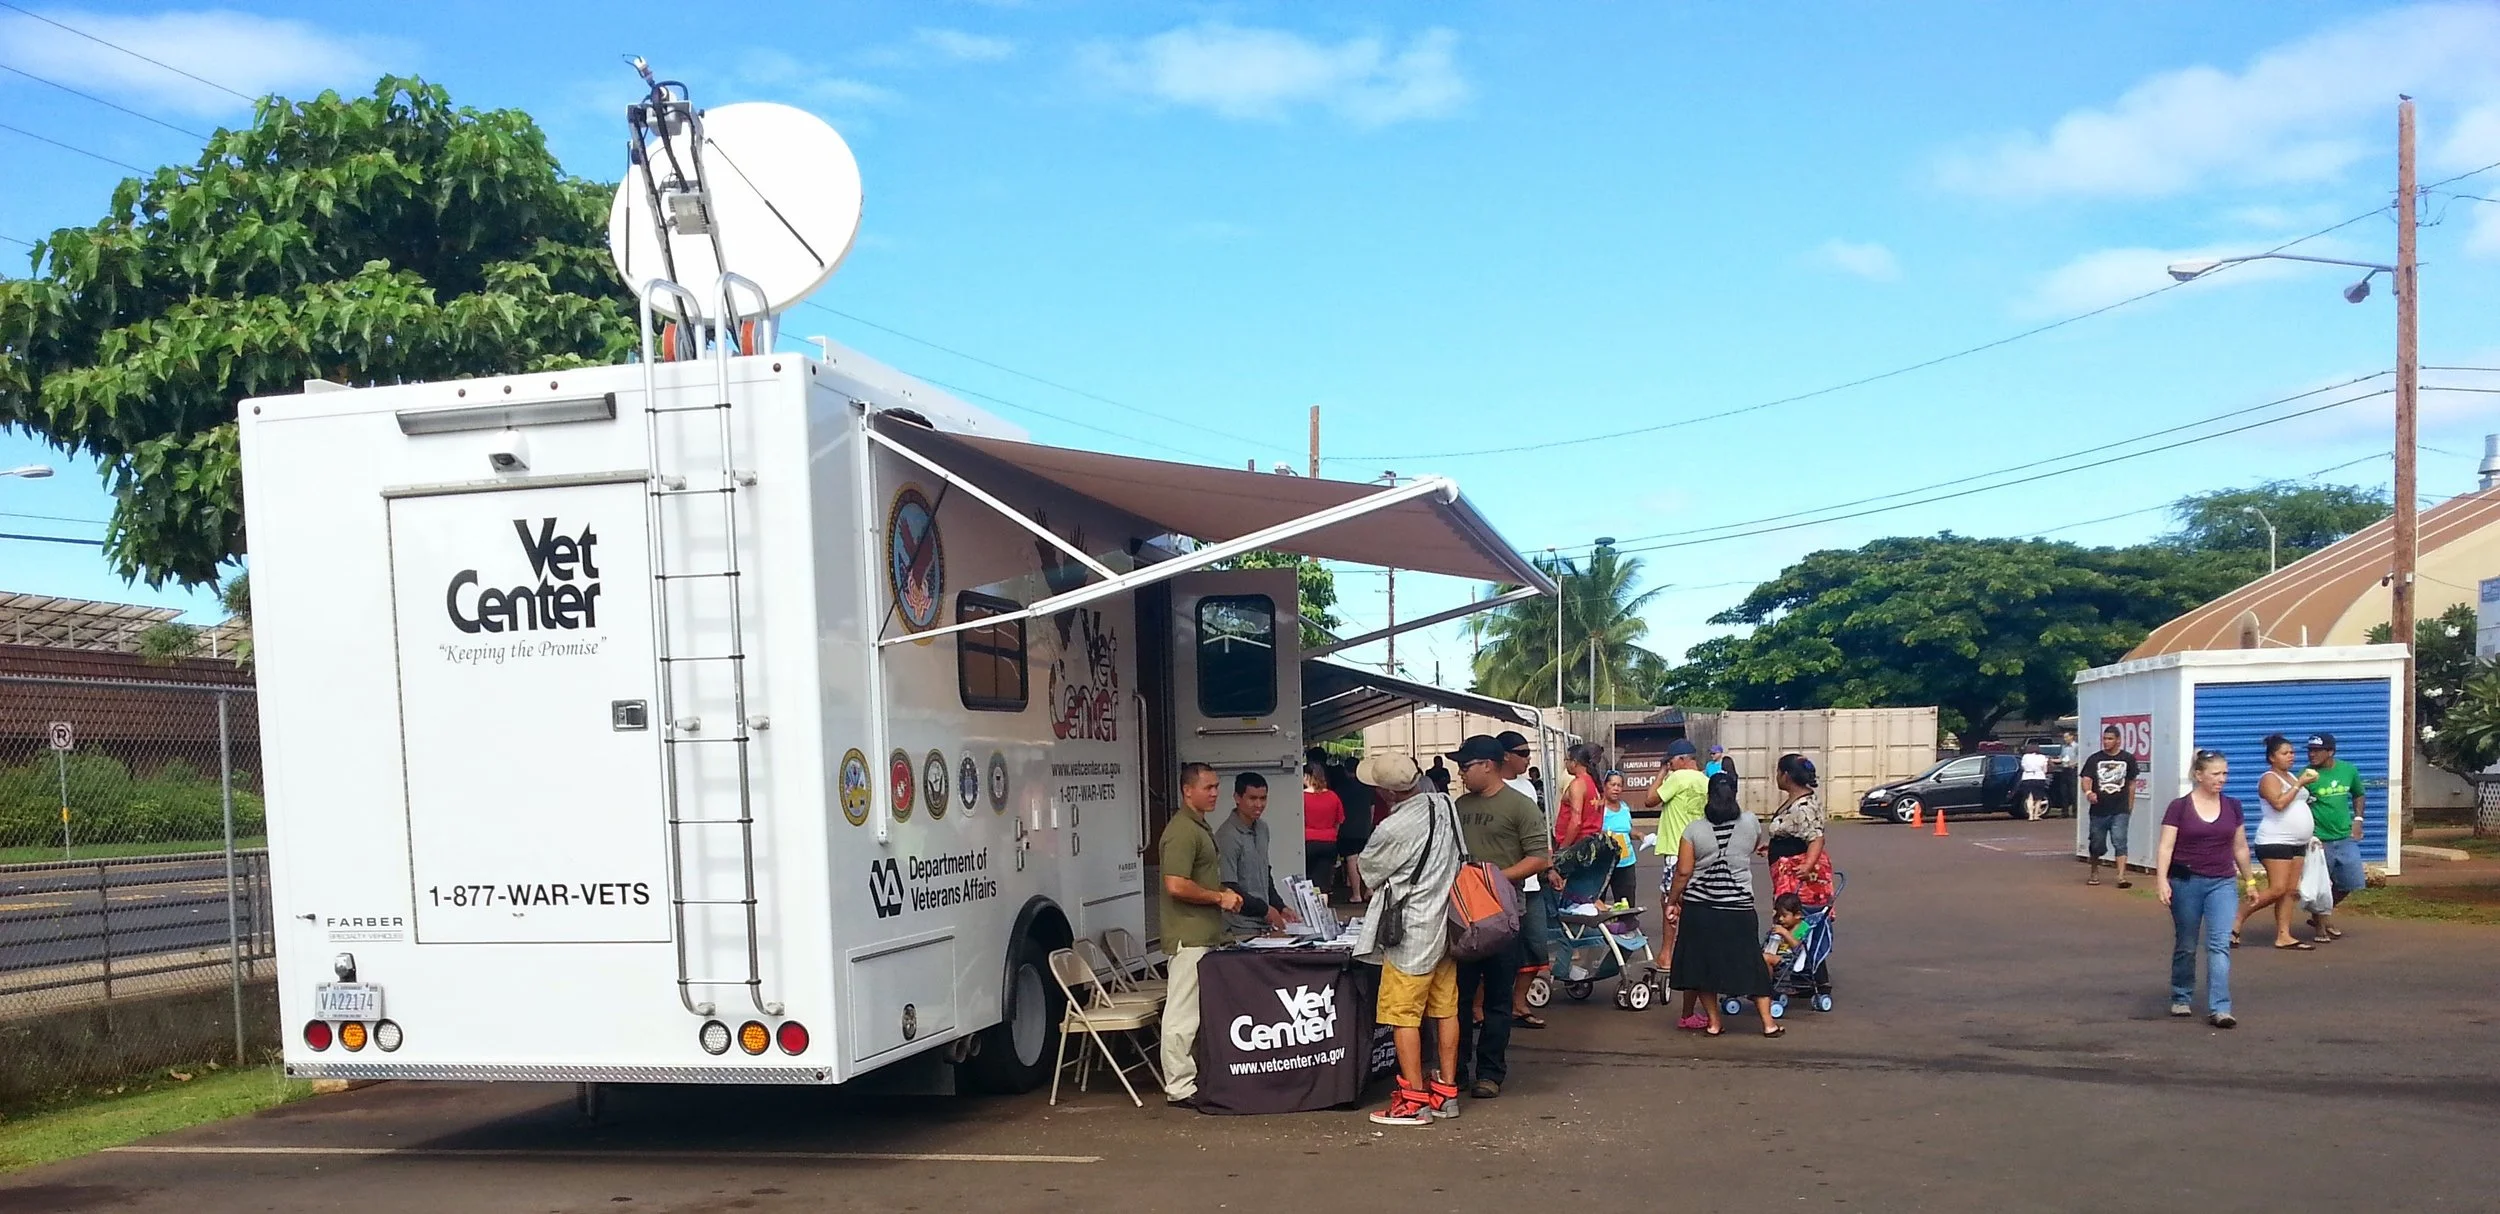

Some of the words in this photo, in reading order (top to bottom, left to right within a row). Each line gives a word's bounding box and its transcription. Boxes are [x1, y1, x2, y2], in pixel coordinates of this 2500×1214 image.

[512, 517, 599, 582] Vet
[446, 569, 601, 634] Center
[511, 639, 534, 658] the
[1080, 607, 1118, 688] Vet
[1049, 659, 1118, 742] Center
[1052, 761, 1121, 779] www.vetcenter.va.gov
[1623, 760, 1649, 769] HAWAII
[1060, 783, 1116, 802] 1-877-WAR-VETS
[908, 850, 975, 884] Department
[976, 846, 987, 870] of
[429, 882, 650, 907] 1-877-WAR-VETS
[870, 861, 904, 914] VA
[910, 885, 961, 912] Veterans
[962, 876, 997, 903] Affairs
[327, 917, 403, 927] FARBER
[321, 993, 373, 1011] VA22174
[1275, 983, 1336, 1021] Vet
[1229, 1012, 1337, 1052] Center
[1229, 1047, 1346, 1076] www.vetcenter.va.gov
